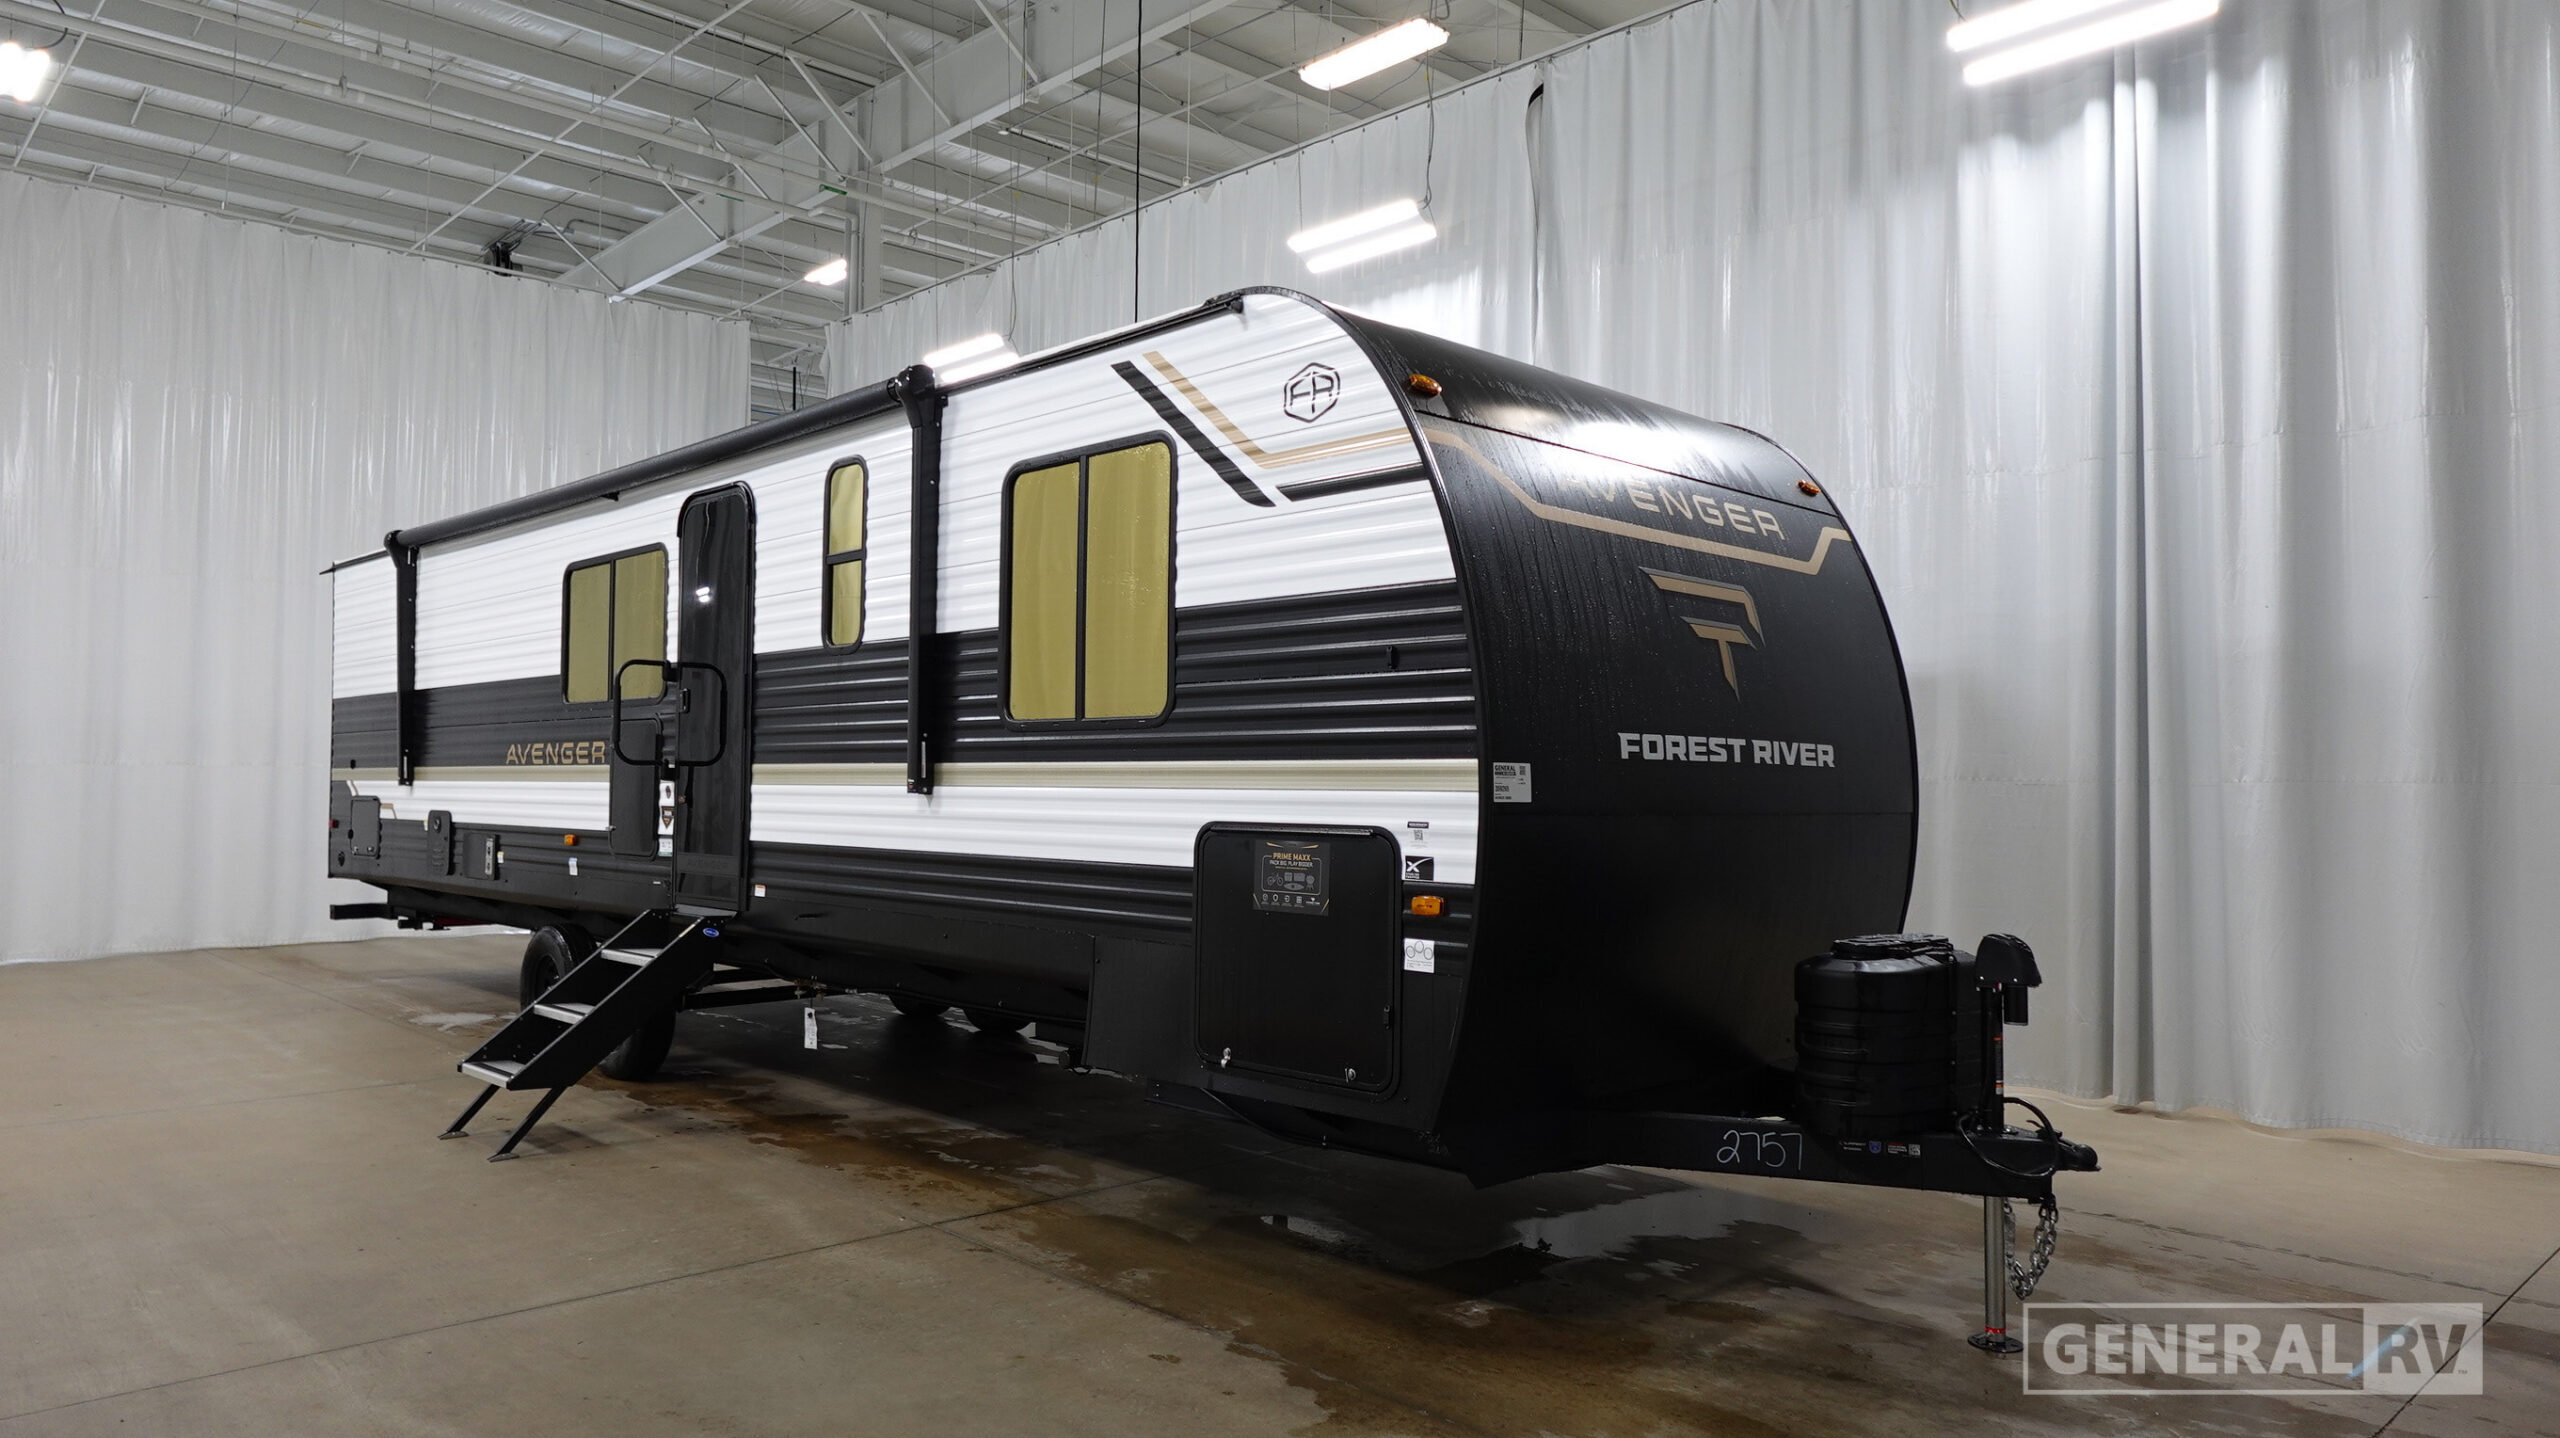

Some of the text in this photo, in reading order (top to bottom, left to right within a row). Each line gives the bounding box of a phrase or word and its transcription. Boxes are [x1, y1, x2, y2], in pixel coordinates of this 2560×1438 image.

[505, 741, 606, 765] AVENGER
[1617, 732, 1836, 768] FOREST RIVER
[1272, 852, 1311, 862] PRIME MAXX
[1716, 1129, 1803, 1172] 2757
